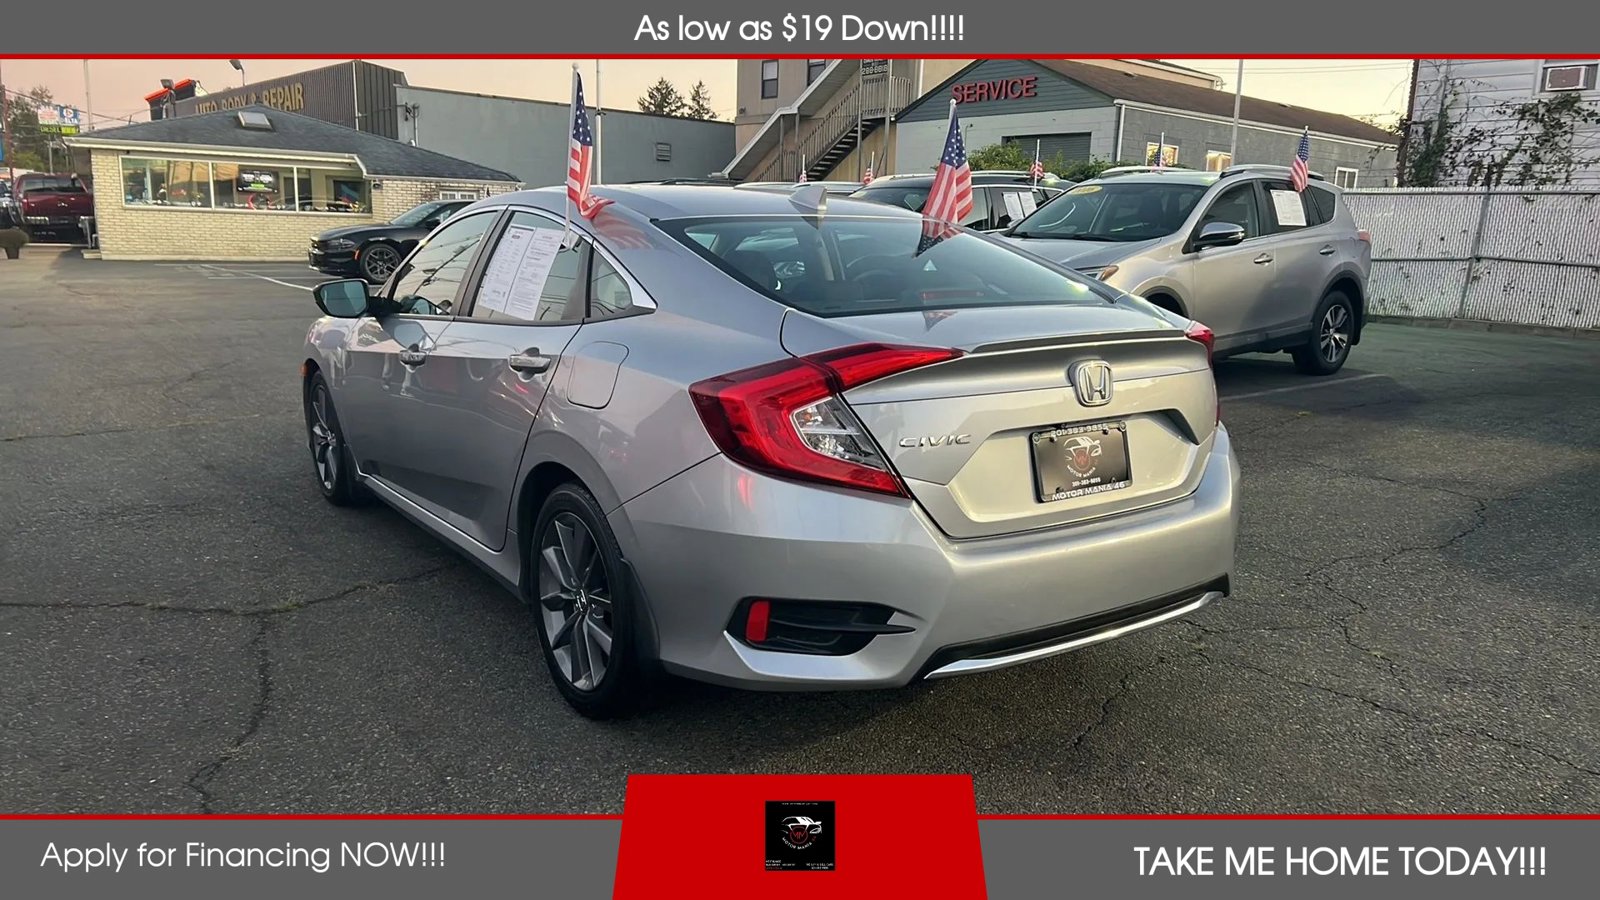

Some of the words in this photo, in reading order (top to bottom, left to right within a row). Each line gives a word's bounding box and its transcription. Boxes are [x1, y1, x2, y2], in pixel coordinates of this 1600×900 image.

[263, 82, 304, 111] REPAIR
[952, 75, 1038, 104] SERVICE
[899, 434, 971, 447] CIVIC
[1051, 489, 1083, 501] MOTOR
[1084, 484, 1113, 495] MANIA
[1113, 481, 1125, 490] 46
